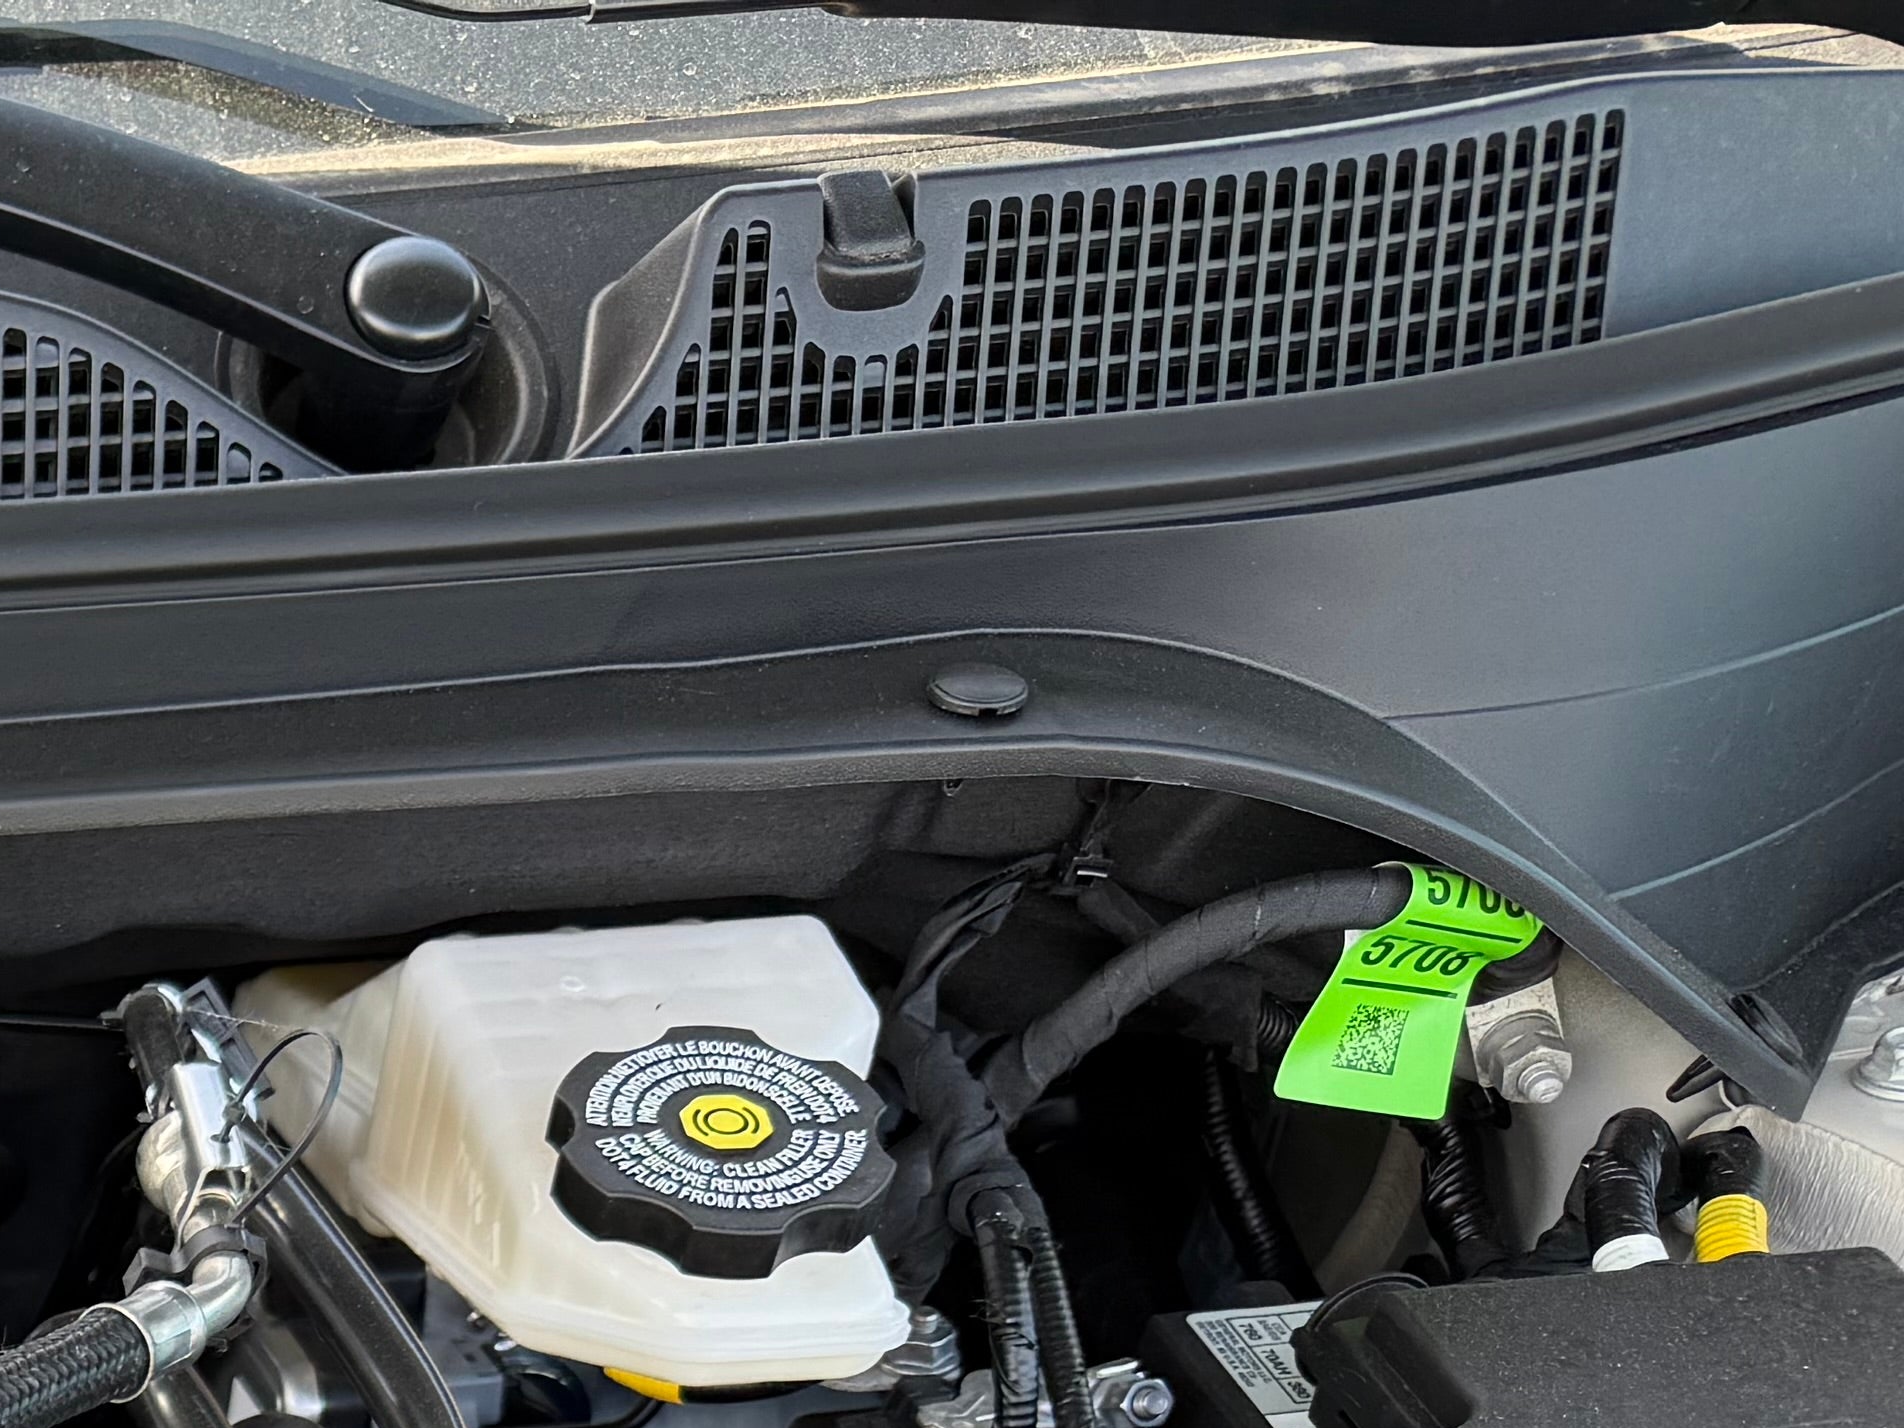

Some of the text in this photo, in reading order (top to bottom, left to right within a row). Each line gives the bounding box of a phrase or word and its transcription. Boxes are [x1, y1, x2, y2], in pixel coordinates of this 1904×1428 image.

[1361, 934, 1484, 976] 5708
[673, 1041, 699, 1056] LE
[697, 1040, 775, 1062] BOUCHON
[768, 1052, 824, 1082] AVANT
[615, 1132, 654, 1160] CAP
[638, 1153, 709, 1188] BEFORE
[809, 1129, 842, 1161] ONLY
[638, 1128, 816, 1177] WARNING: CLEAN FILLER
[621, 1165, 680, 1196] FLUID
[675, 1186, 733, 1208] FROM
[750, 1181, 823, 1208] SEALED
